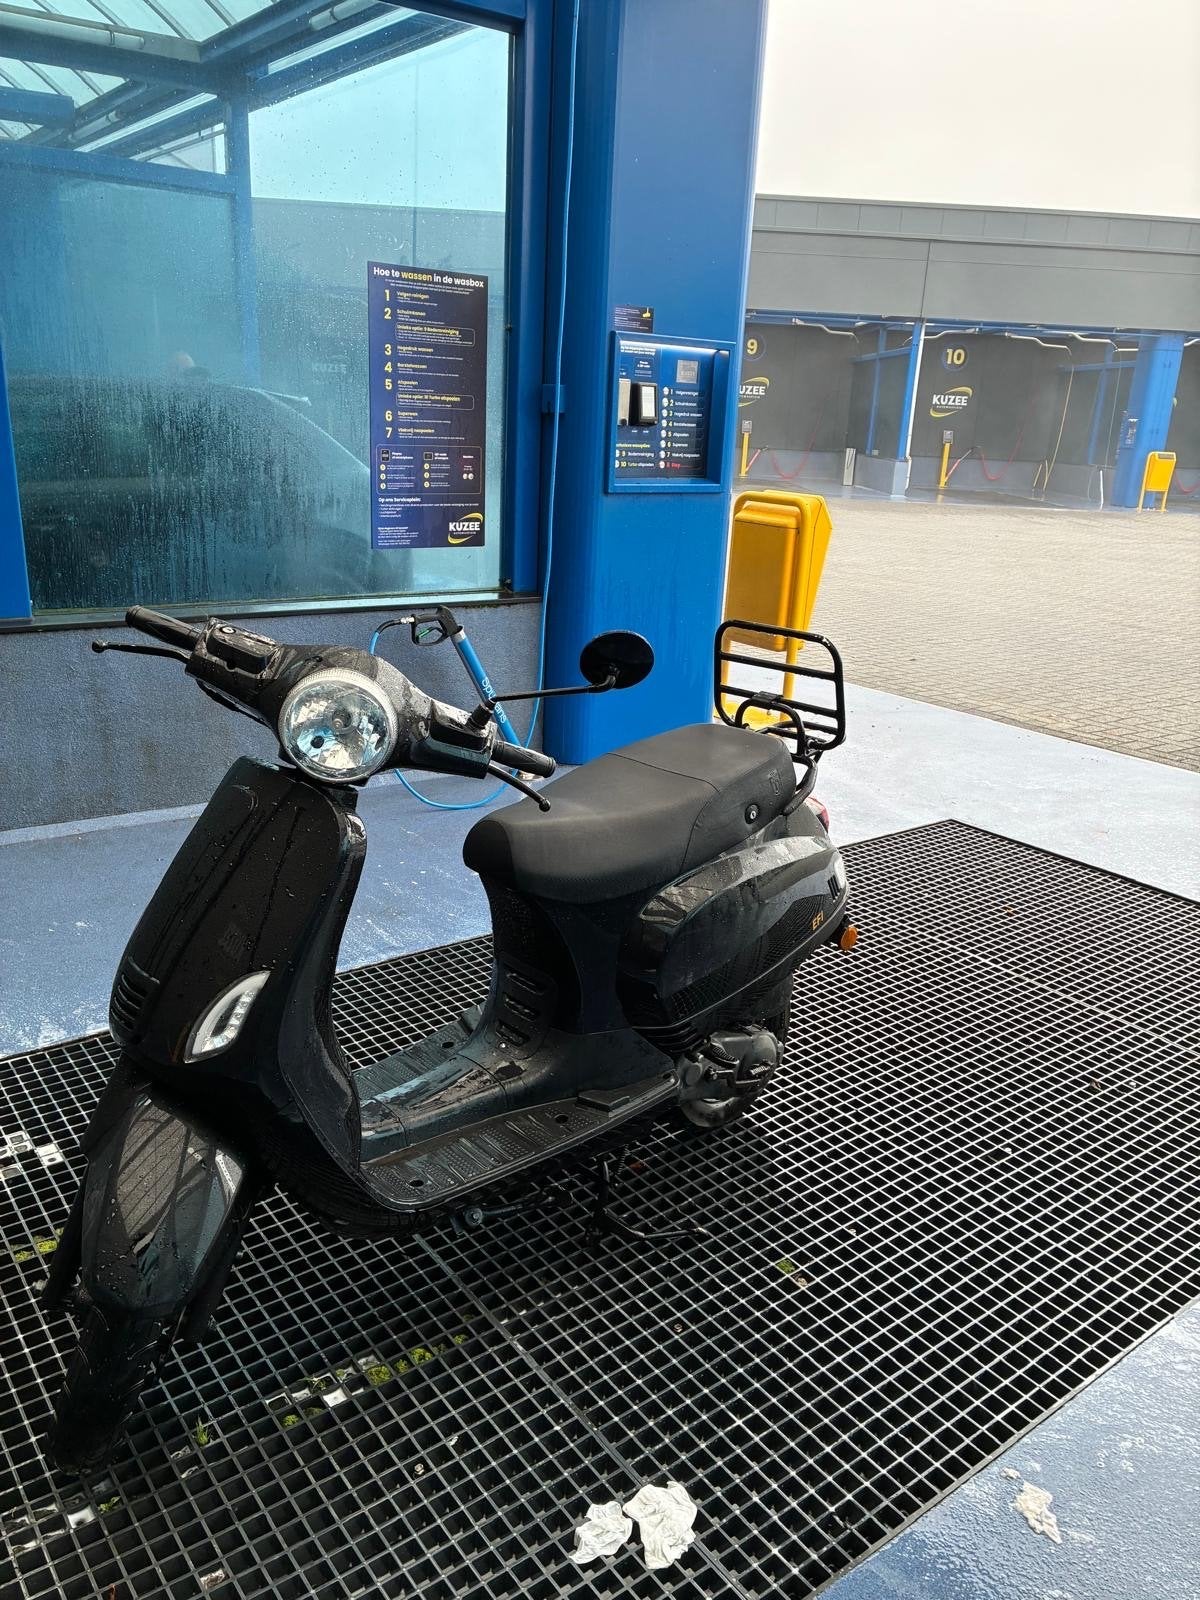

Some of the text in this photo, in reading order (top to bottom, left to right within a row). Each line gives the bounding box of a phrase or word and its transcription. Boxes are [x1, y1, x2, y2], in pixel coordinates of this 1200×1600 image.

[373, 266, 390, 277] Hoe
[391, 269, 400, 278] te
[401, 271, 433, 282] wassen
[433, 273, 441, 283] in
[442, 275, 453, 284] de
[453, 277, 484, 288] wasbox
[384, 289, 390, 301] 1
[384, 307, 392, 320] 2
[384, 343, 392, 356] 3
[746, 338, 758, 355] 9
[946, 348, 966, 365] 10
[384, 361, 393, 373] 4
[384, 378, 393, 390] 5
[739, 385, 766, 396] UZEE
[932, 394, 968, 406] KUZEE
[385, 410, 393, 421] 6
[385, 427, 393, 438] 7
[448, 521, 481, 532] KUZEE
[812, 909, 824, 931] EFI
